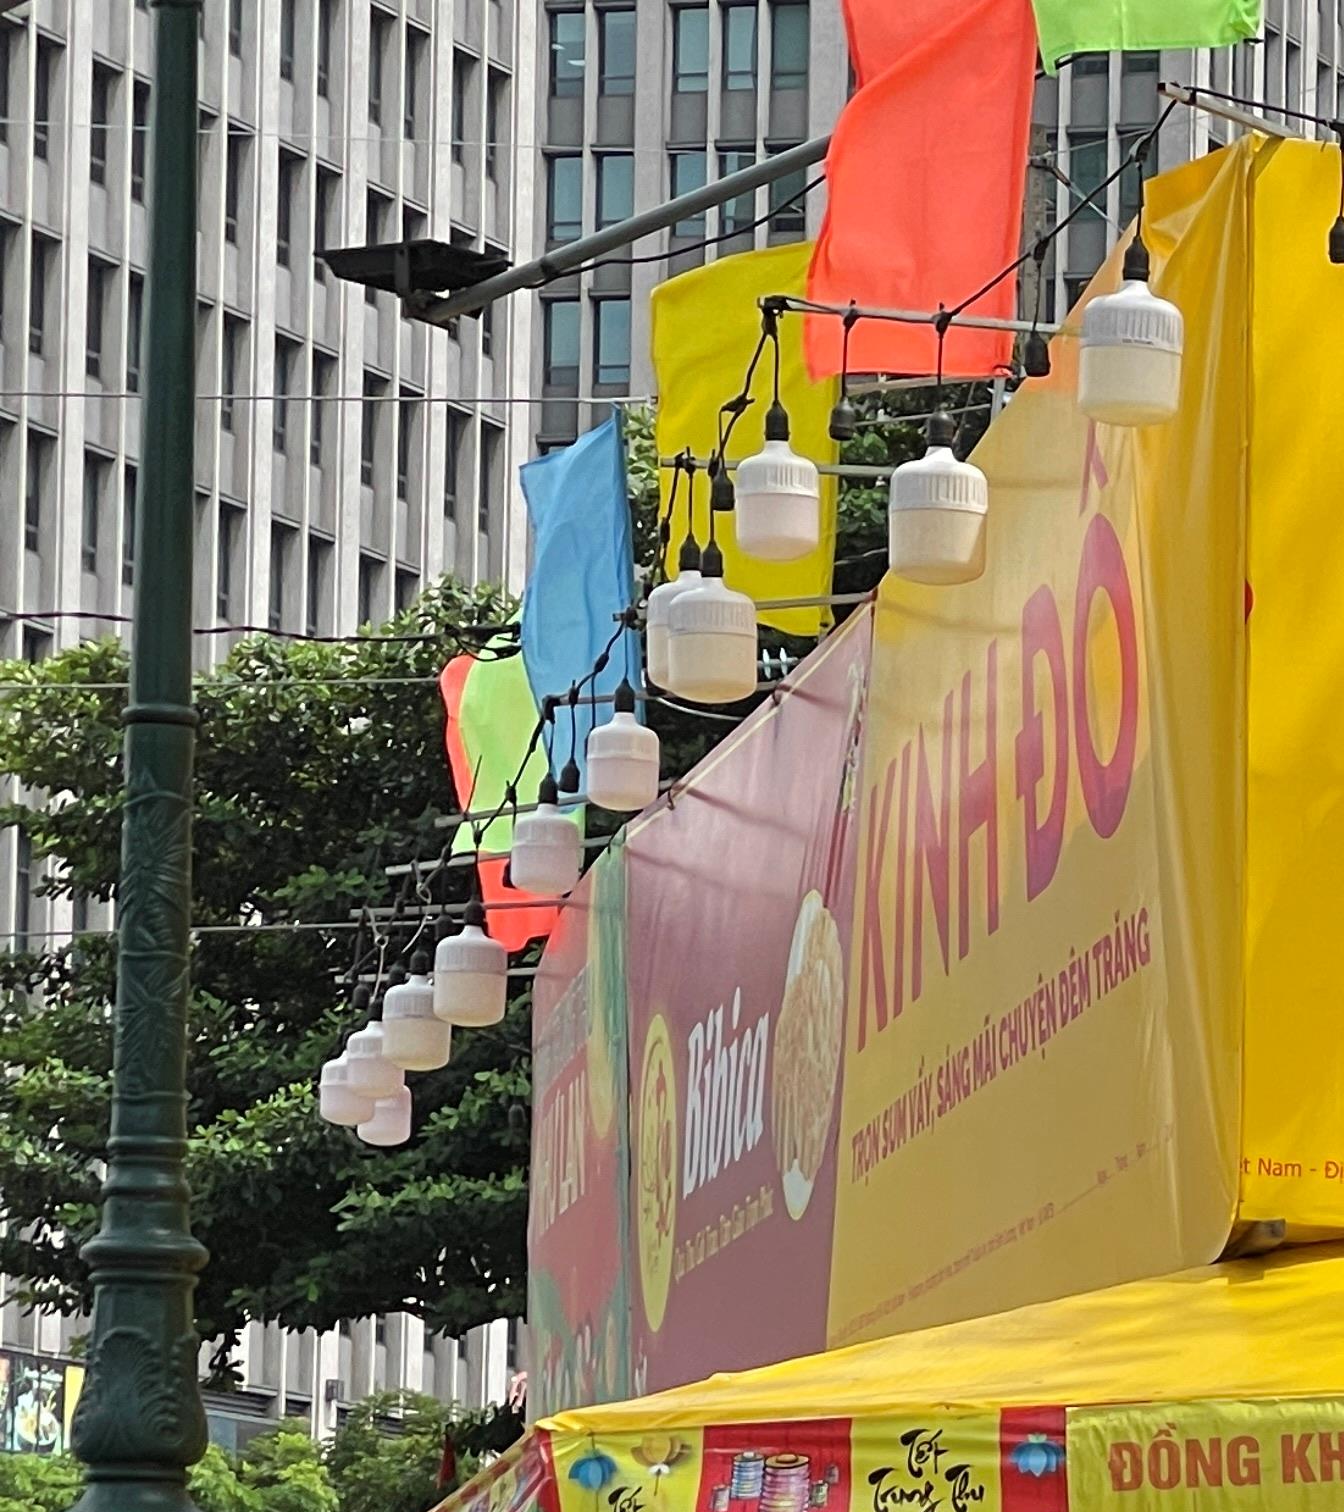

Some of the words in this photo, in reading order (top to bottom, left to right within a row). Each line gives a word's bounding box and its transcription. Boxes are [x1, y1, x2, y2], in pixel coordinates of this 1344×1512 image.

[857, 638, 999, 1054] KINH
[1015, 422, 1138, 902] ĐÔ
[683, 986, 769, 1199] Bibica
[882, 1096, 907, 1160] SUM
[937, 1044, 971, 1118] SÁNG
[999, 973, 1056, 1070] CHUYỆN
[1059, 945, 1091, 1028] ĐÊM
[1093, 908, 1151, 1000] TRĂNG
[1257, 1159, 1302, 1178] Nam
[901, 1429, 949, 1478] Tết
[1108, 1423, 1262, 1492] ĐỒNG
